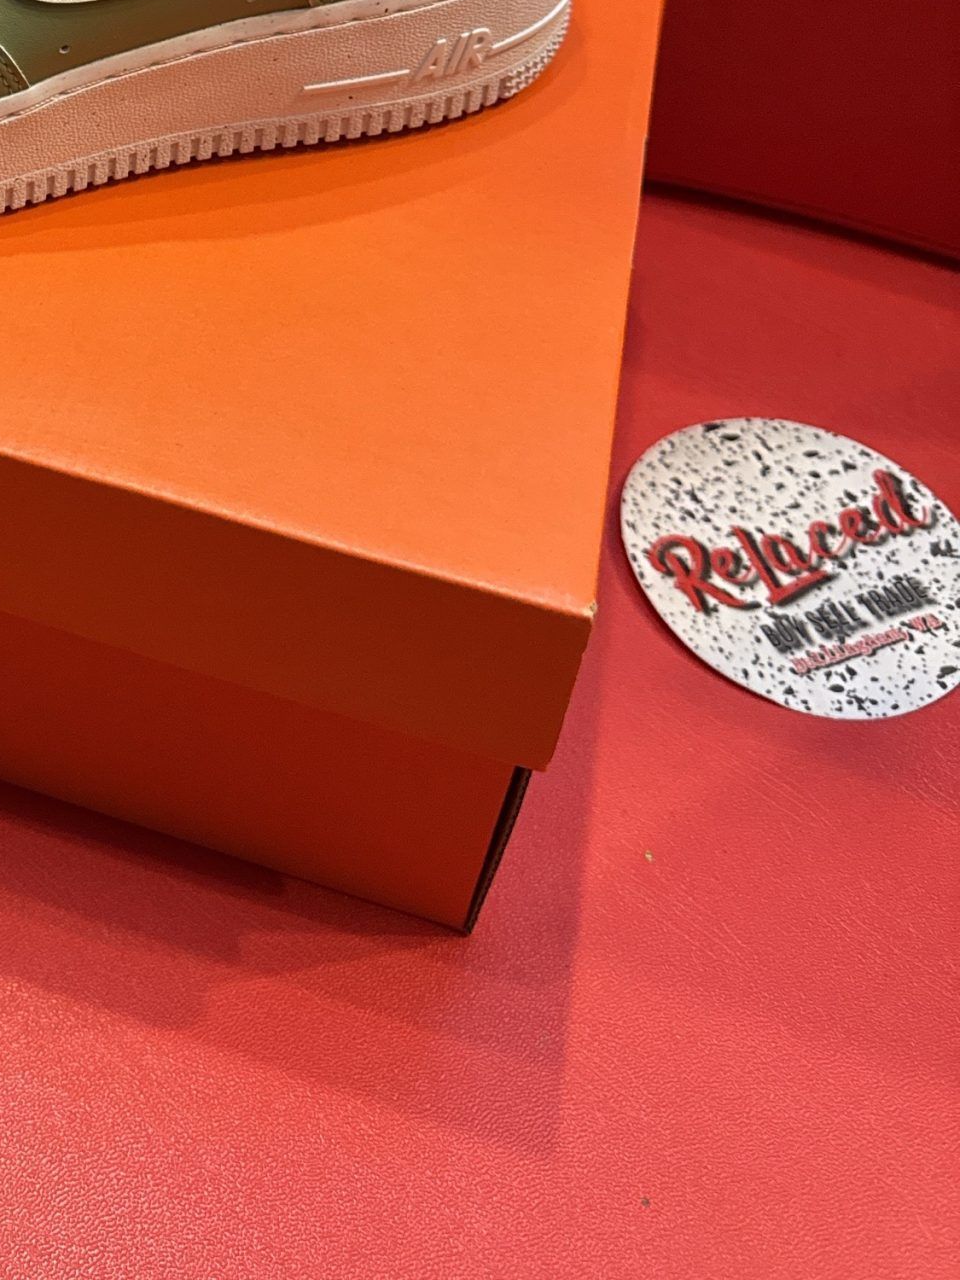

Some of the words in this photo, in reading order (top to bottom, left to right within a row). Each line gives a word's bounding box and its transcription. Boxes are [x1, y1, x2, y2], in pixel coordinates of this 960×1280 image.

[413, 27, 490, 81] AIR
[759, 615, 812, 653] BUY
[804, 600, 866, 639] SELL
[854, 575, 932, 620] TRADE
